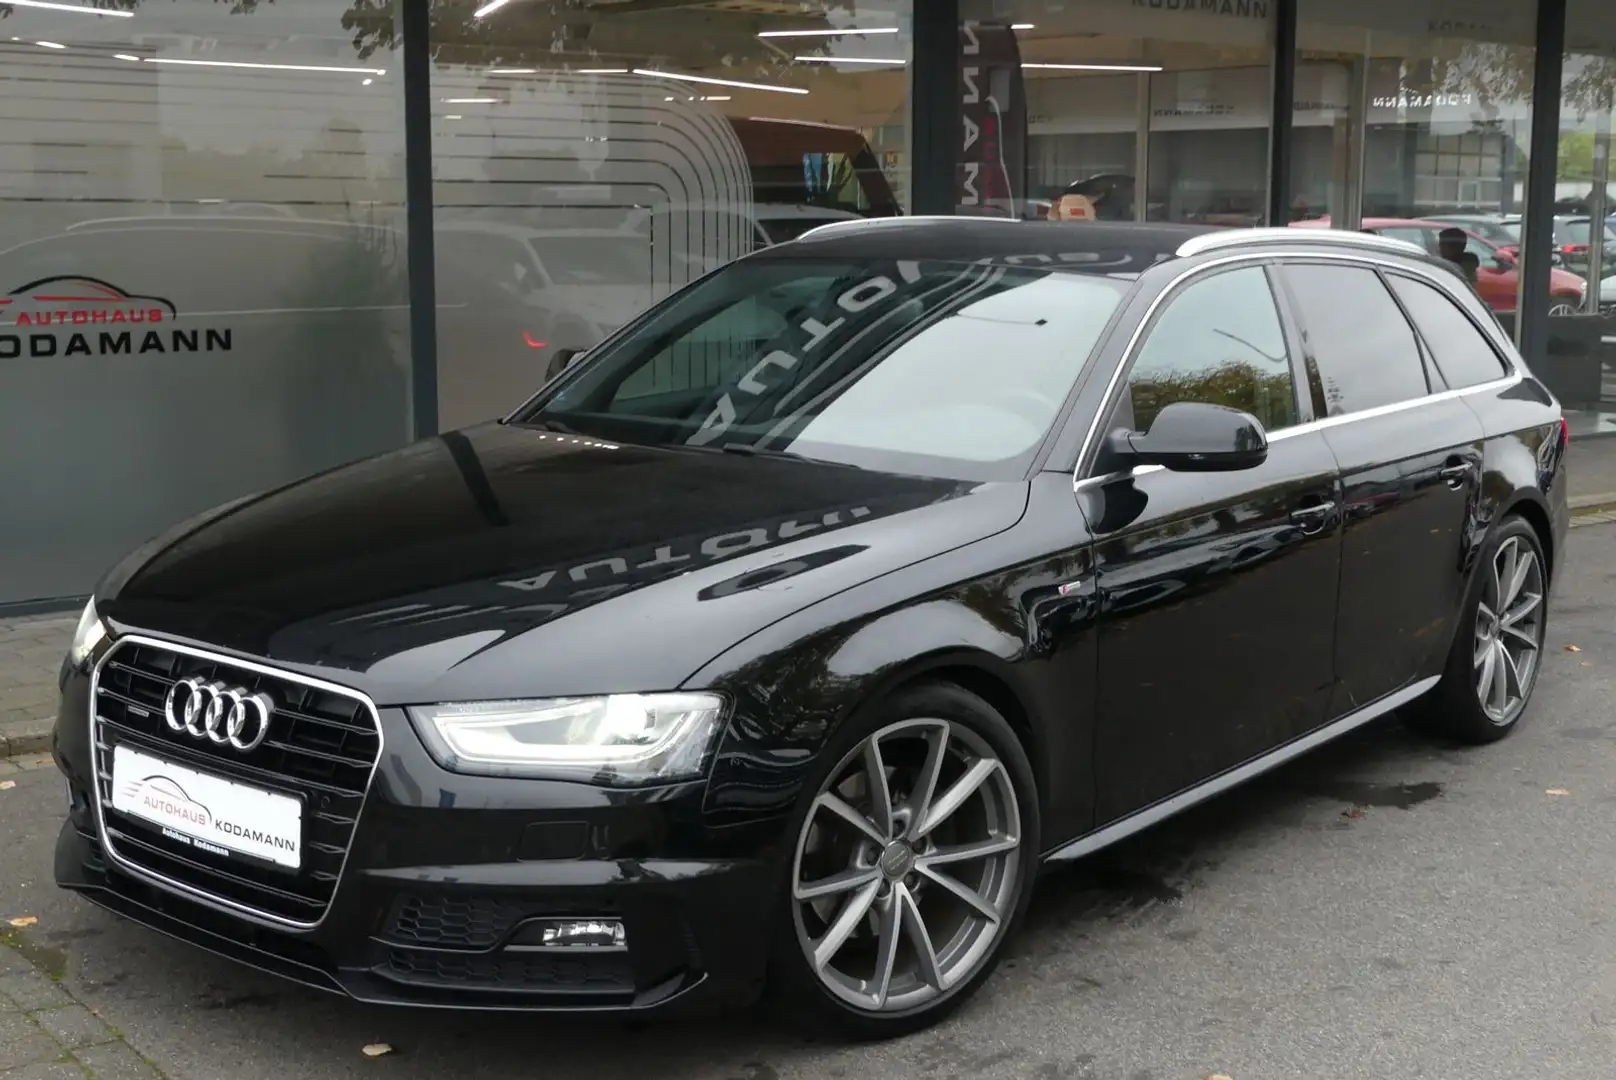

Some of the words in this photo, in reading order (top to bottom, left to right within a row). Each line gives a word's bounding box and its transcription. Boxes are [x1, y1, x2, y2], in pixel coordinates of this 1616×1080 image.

[16, 308, 163, 326] AUTOHAUS
[143, 795, 206, 826] AUTOHAUS
[215, 818, 295, 851] KODAMANN
